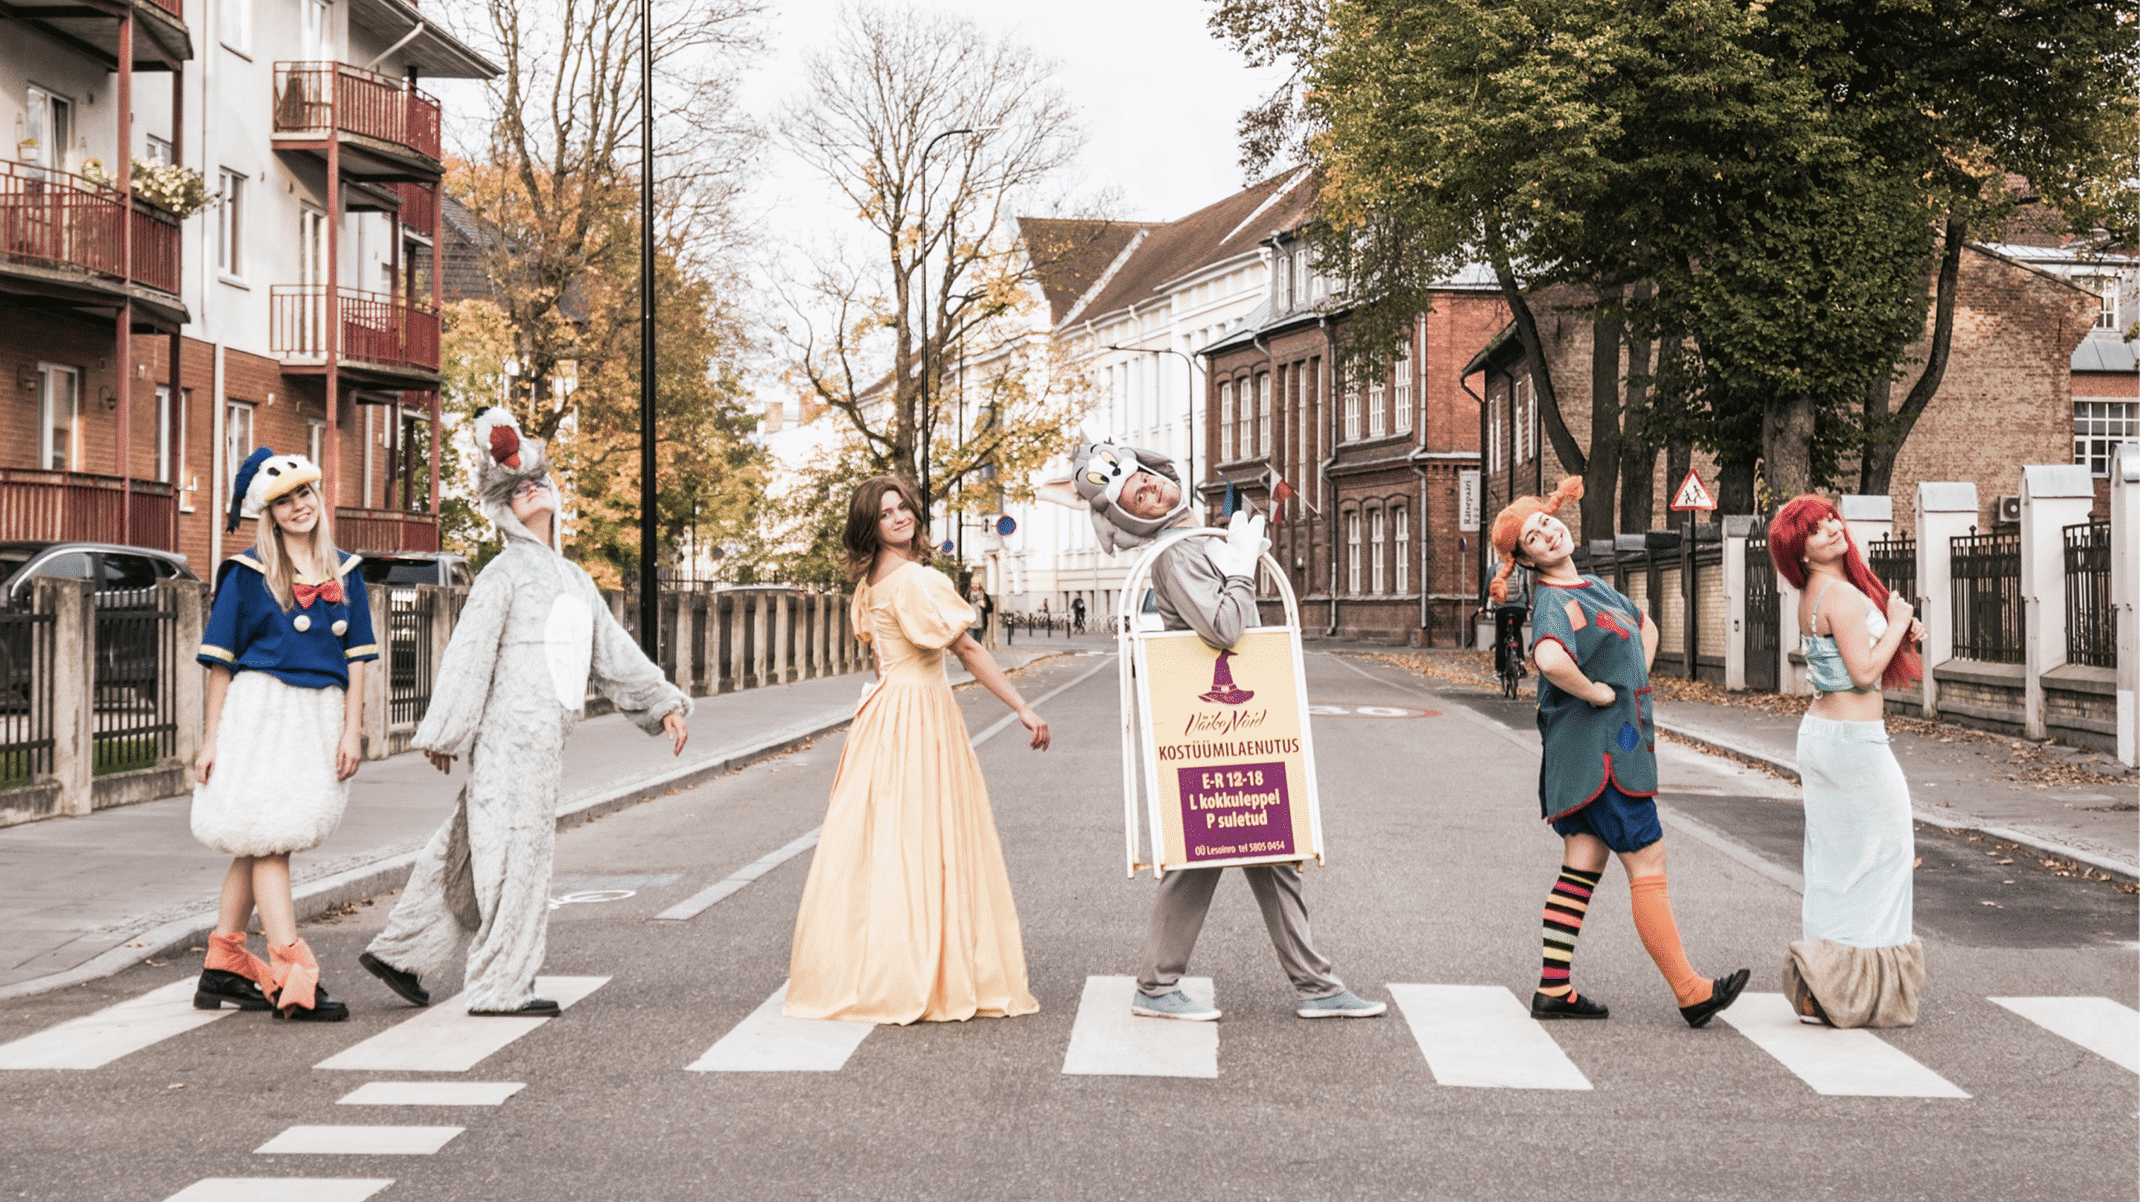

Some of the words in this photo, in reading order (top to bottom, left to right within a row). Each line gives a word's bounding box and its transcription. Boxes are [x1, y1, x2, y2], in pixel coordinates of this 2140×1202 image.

[1184, 711, 1226, 737] Väike
[1158, 737, 1300, 761] KOSTÜÜMILAENUTUS
[1202, 772, 1225, 790] E-R
[1226, 770, 1264, 788] 12-18
[1189, 793, 1198, 810] L
[1199, 788, 1281, 810] kokkuleppel
[1206, 812, 1215, 829] P
[1217, 809, 1268, 829] suletud
[1195, 844, 1206, 856] OÜ
[1238, 843, 1248, 853] tel
